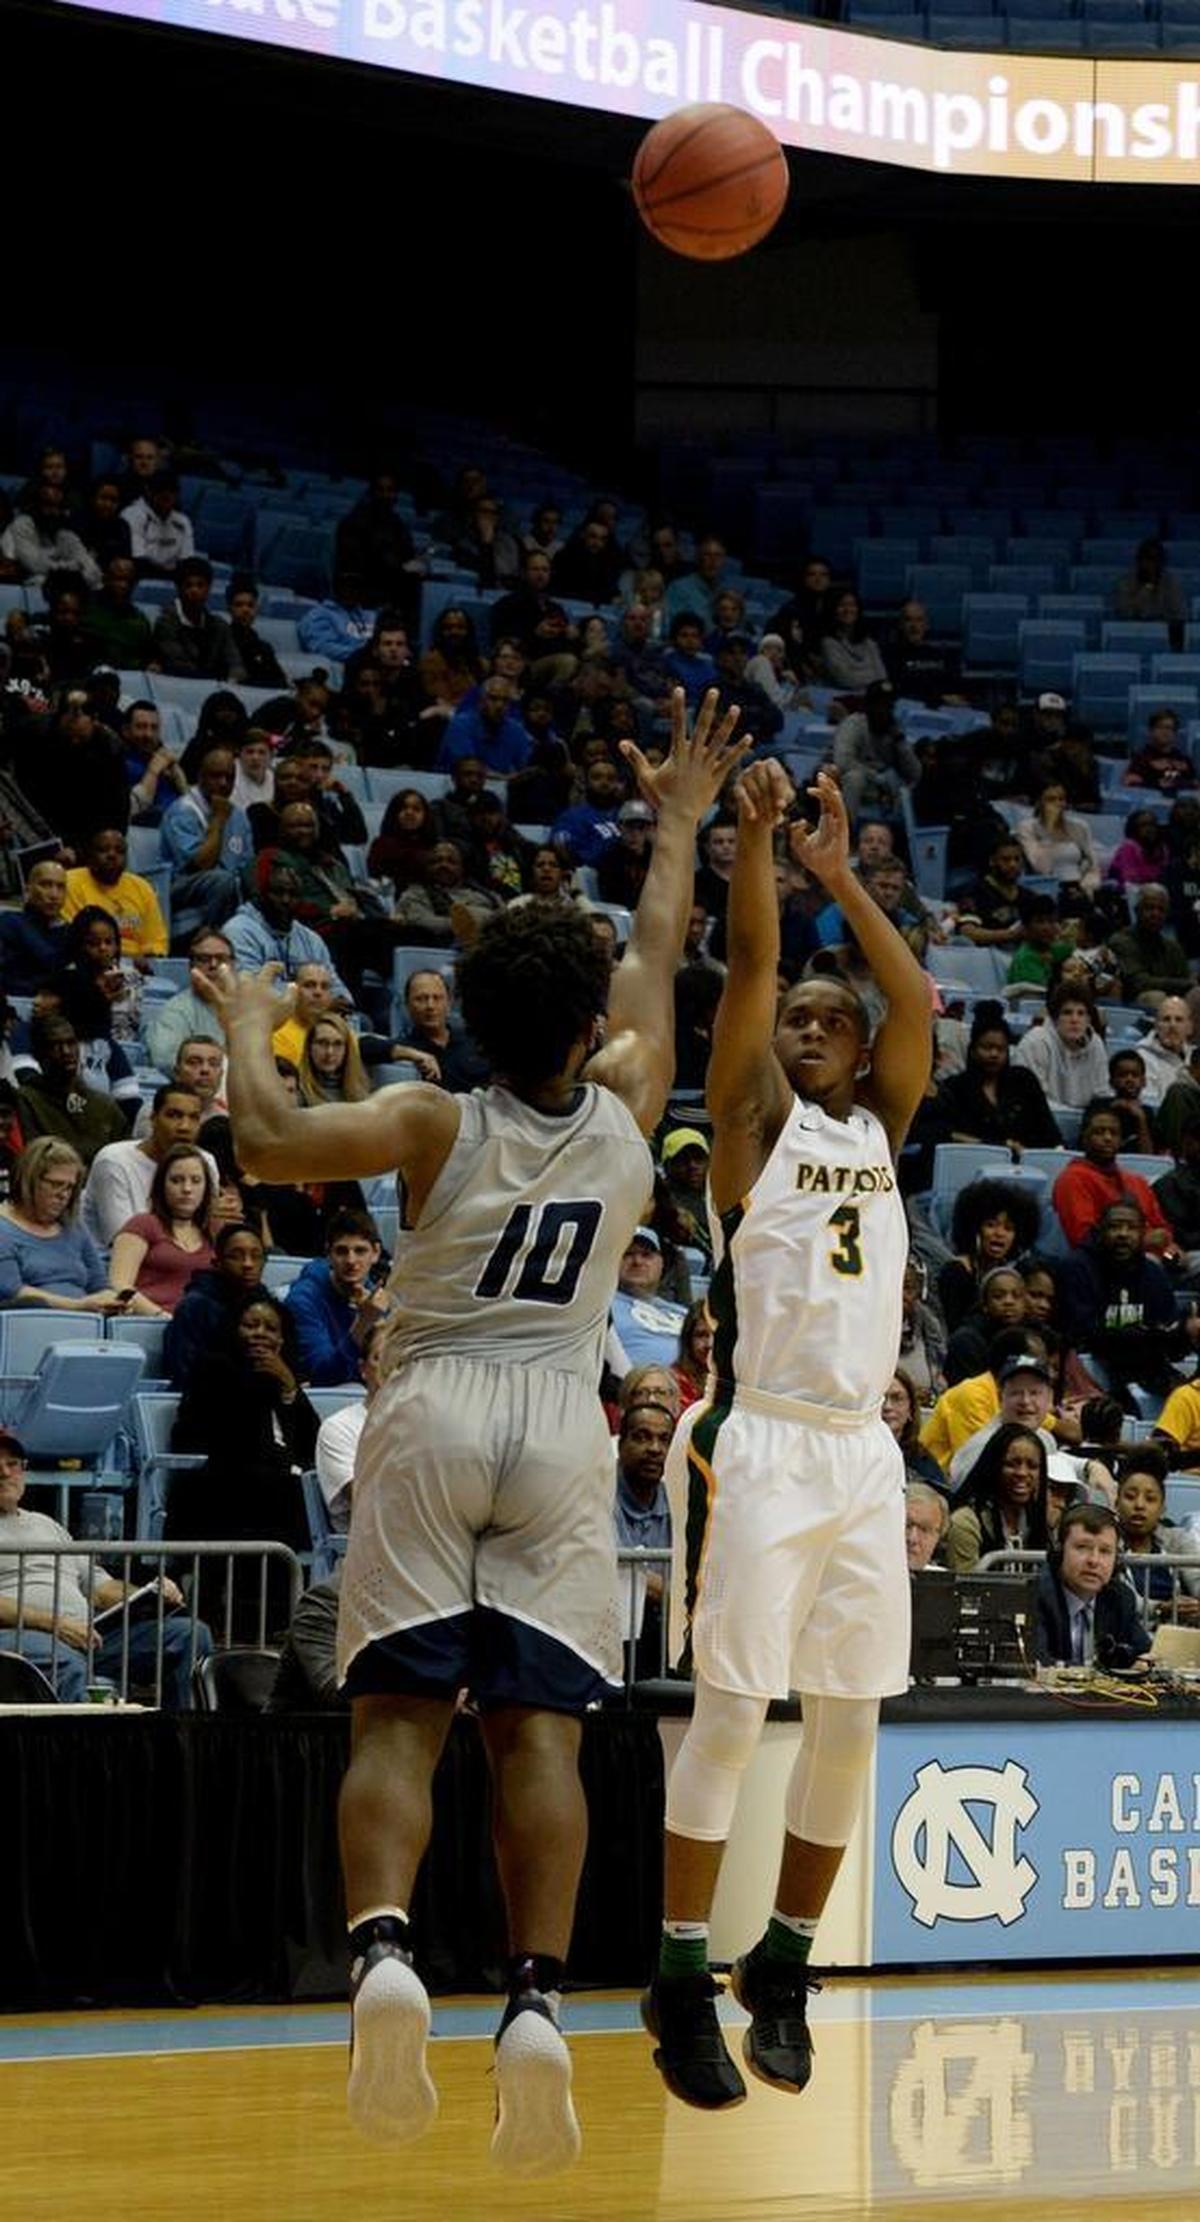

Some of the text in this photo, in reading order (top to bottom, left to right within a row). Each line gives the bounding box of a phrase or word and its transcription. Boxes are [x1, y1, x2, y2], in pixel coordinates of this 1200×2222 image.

[474, 1199, 605, 1308] 10
[827, 1204, 863, 1277] 3
[1111, 1772, 1200, 1833] CA
